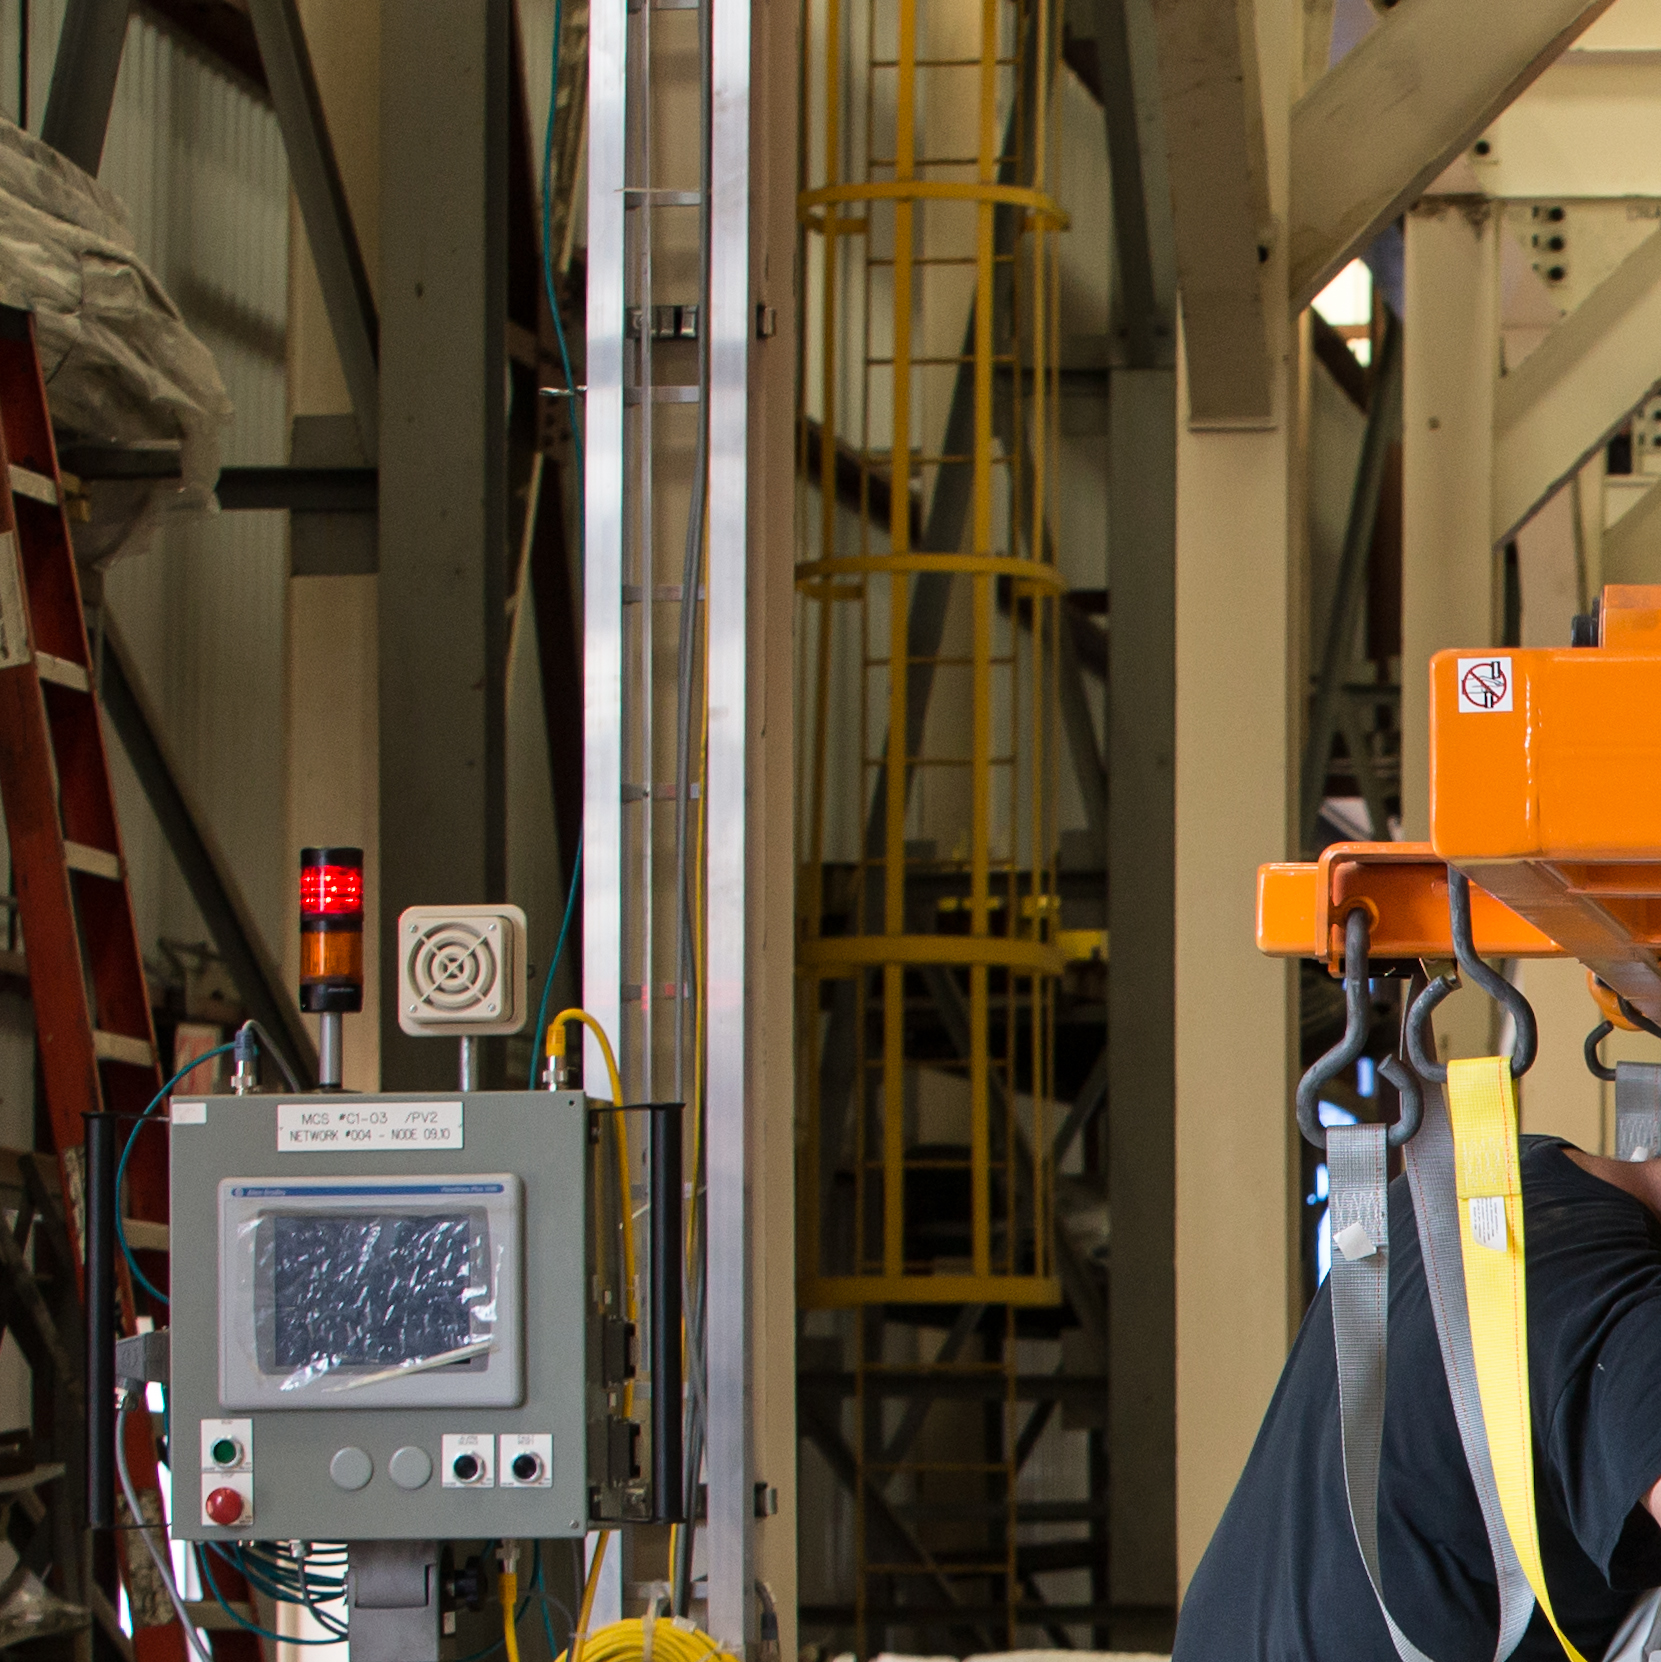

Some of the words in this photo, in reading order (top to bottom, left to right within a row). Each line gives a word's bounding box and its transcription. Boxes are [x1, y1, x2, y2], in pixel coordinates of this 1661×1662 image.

[301, 1113, 330, 1125] MCS
[339, 1112, 388, 1124] #C1-03
[404, 1111, 438, 1124] /PV2
[289, 1130, 339, 1142] NETWORK
[345, 1129, 372, 1141] #004
[391, 1128, 417, 1141] NODE
